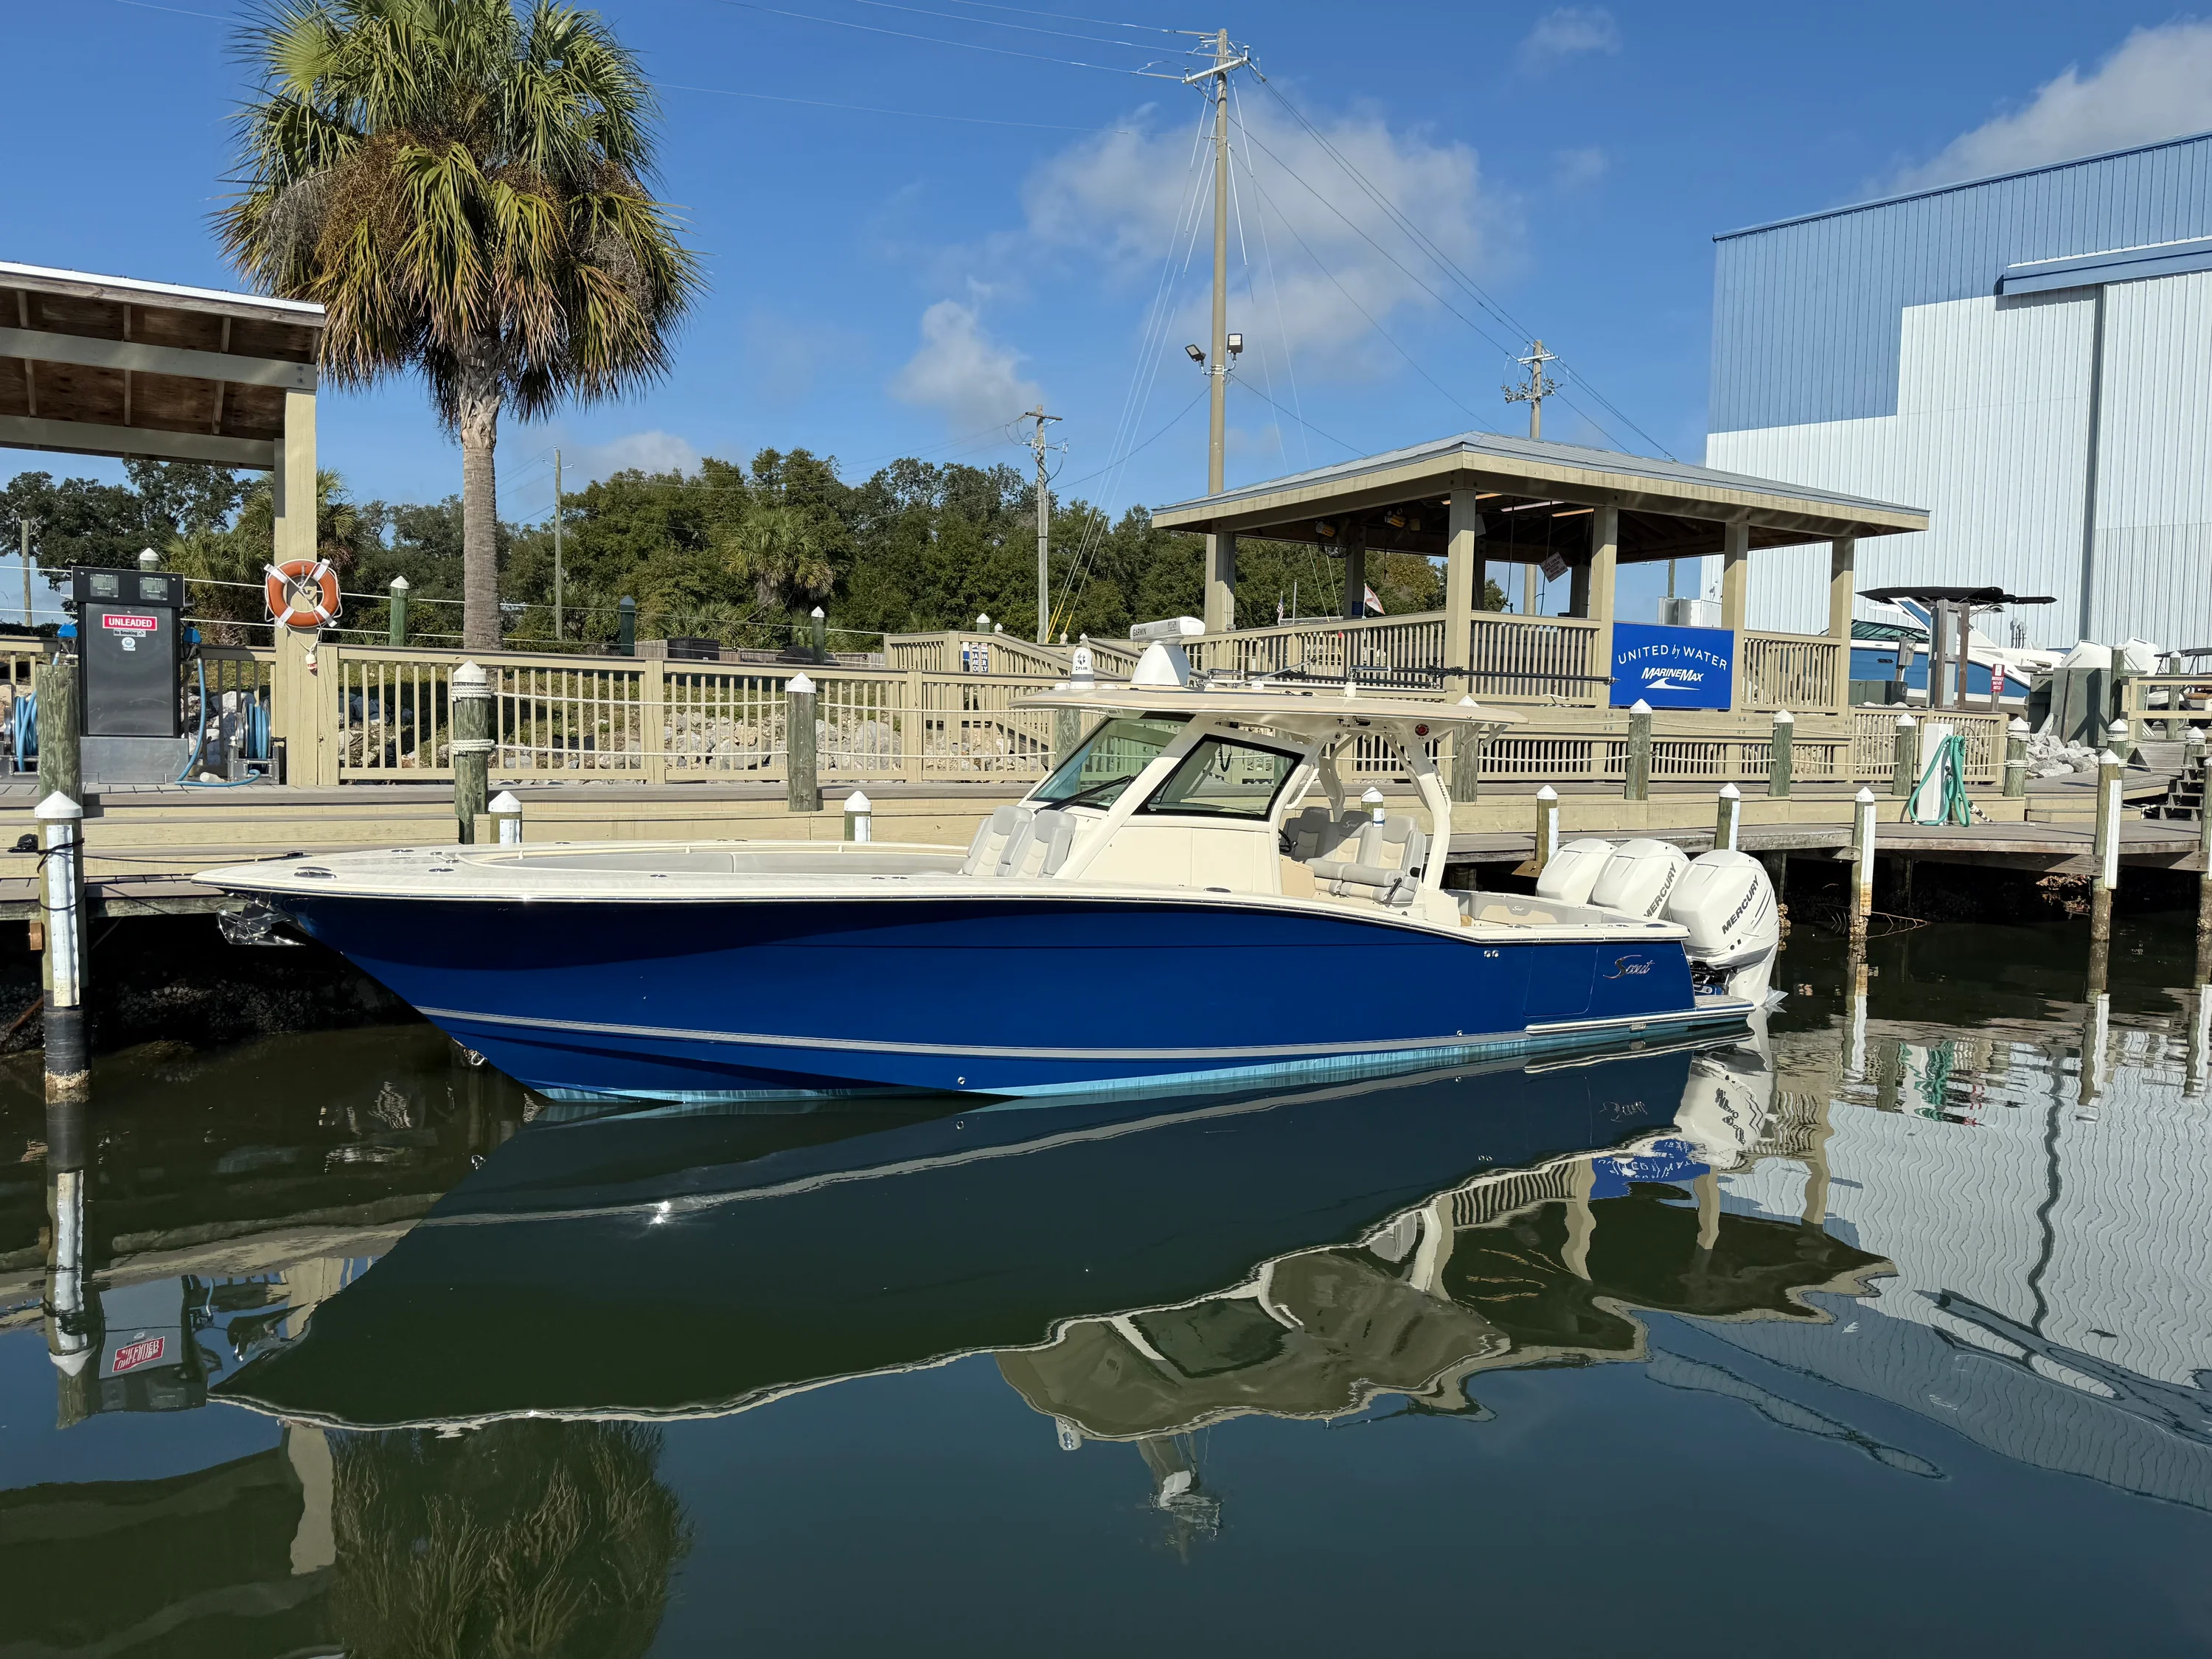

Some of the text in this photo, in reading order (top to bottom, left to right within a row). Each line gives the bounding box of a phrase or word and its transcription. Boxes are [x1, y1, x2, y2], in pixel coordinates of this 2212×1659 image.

[108, 617, 152, 627] UNLEADED
[1133, 627, 1147, 636] GARMIN
[1618, 644, 1728, 670] UNITED by WATER
[1643, 861, 1676, 917] MERCURY
[1722, 874, 1759, 935] MERCURY
[1602, 954, 1655, 979] Scout
